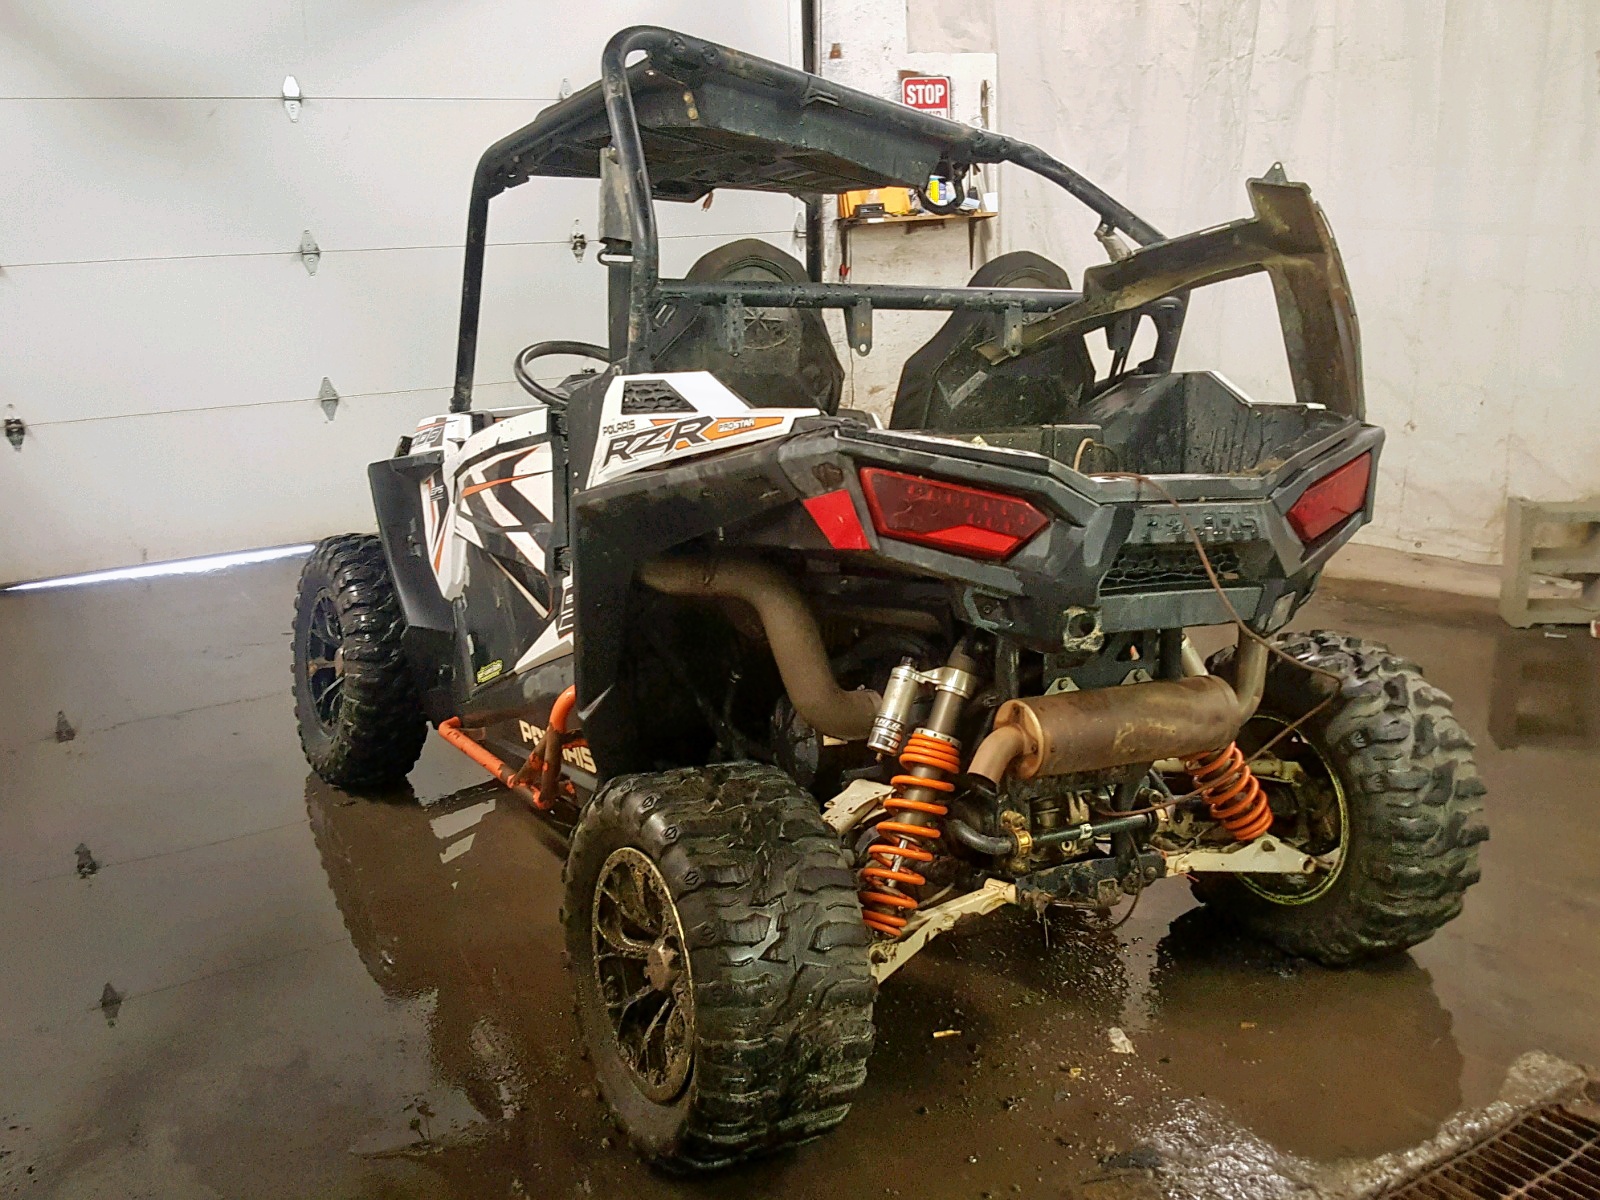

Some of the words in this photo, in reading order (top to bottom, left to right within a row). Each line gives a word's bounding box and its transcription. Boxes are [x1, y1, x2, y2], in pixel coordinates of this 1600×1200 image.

[906, 84, 946, 105] STOP
[602, 419, 636, 436] POLARIS
[602, 415, 715, 468] RZR
